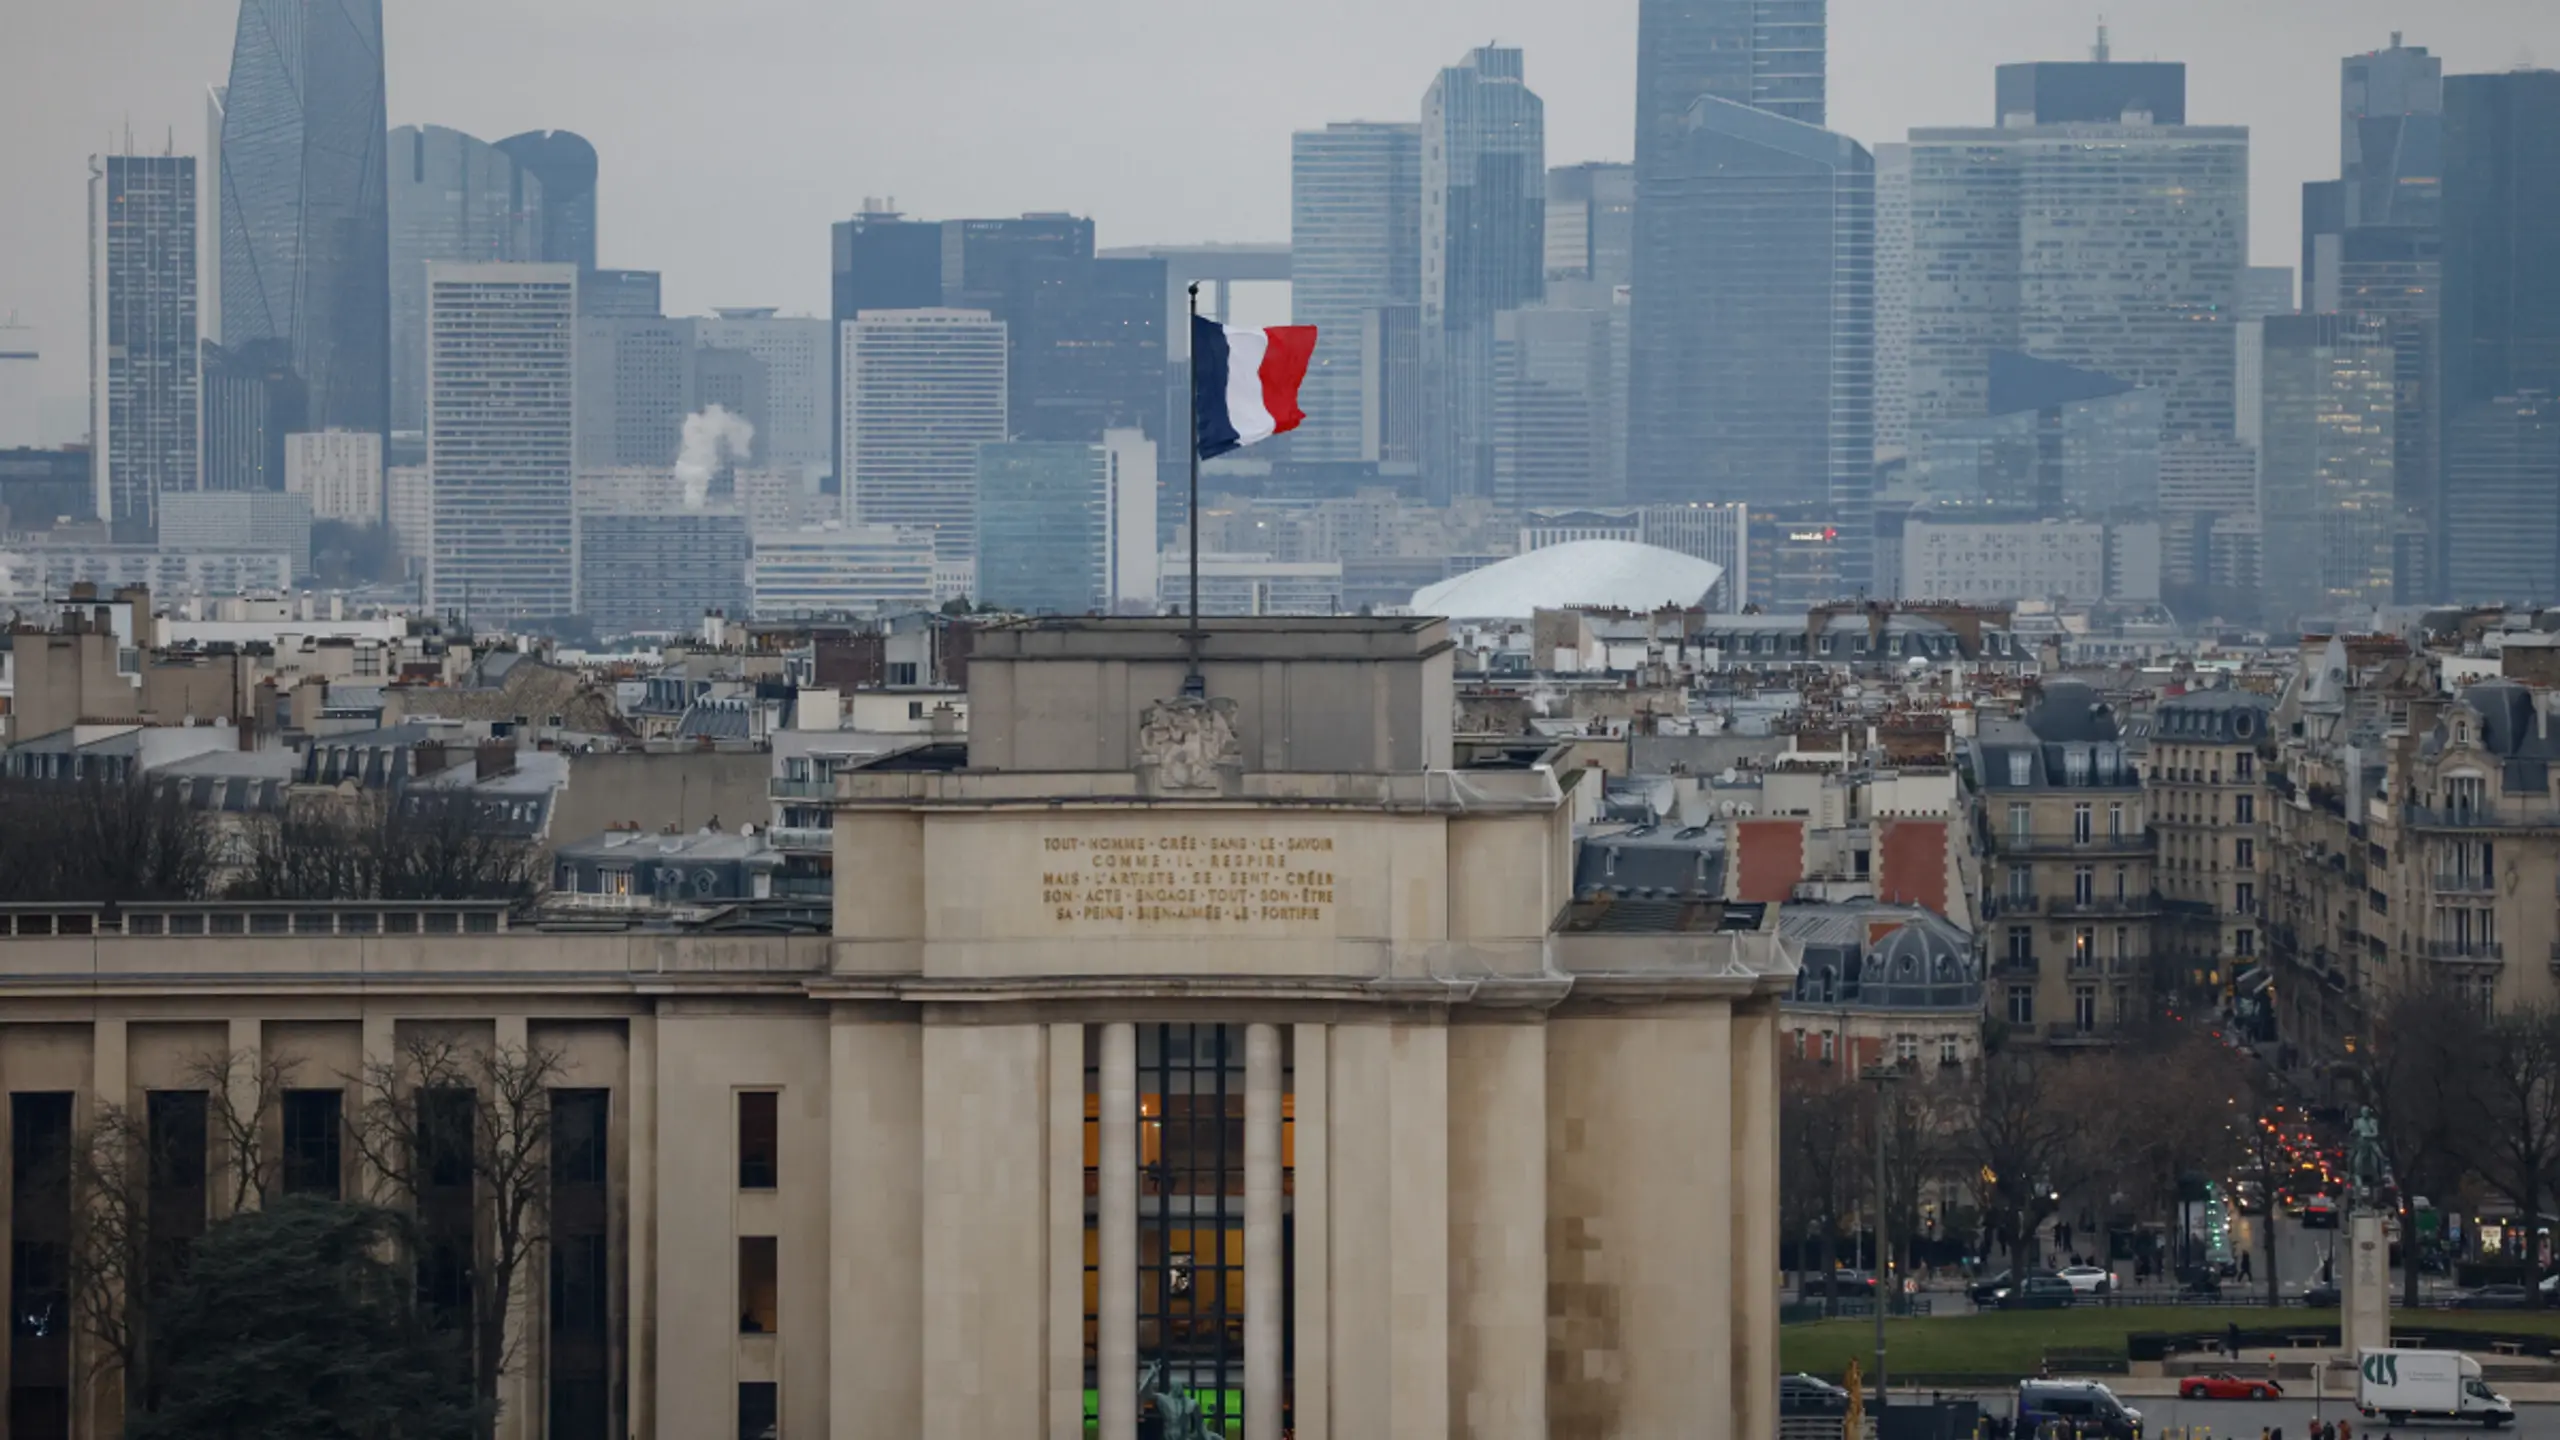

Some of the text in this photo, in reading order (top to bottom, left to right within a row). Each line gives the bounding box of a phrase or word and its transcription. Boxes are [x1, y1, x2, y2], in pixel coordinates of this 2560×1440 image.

[1043, 835, 1333, 851] TOUT HOMME CRÉE SANS LE SAVOIR
[1092, 854, 1286, 867] COMME IL RESPIRE
[1043, 871, 1080, 885] MAIS
[1192, 871, 1212, 885] SE
[1285, 869, 1334, 885] CRÉER
[1043, 887, 1333, 902] SON ACTE ENGAGE TOUT SON ÊTRE
[1056, 906, 1073, 920] SA
[1084, 905, 1124, 920] PEINE
[1233, 906, 1249, 920] LE
[1261, 906, 1321, 920] FORTIFIE
[2364, 1353, 2398, 1388] CLS
